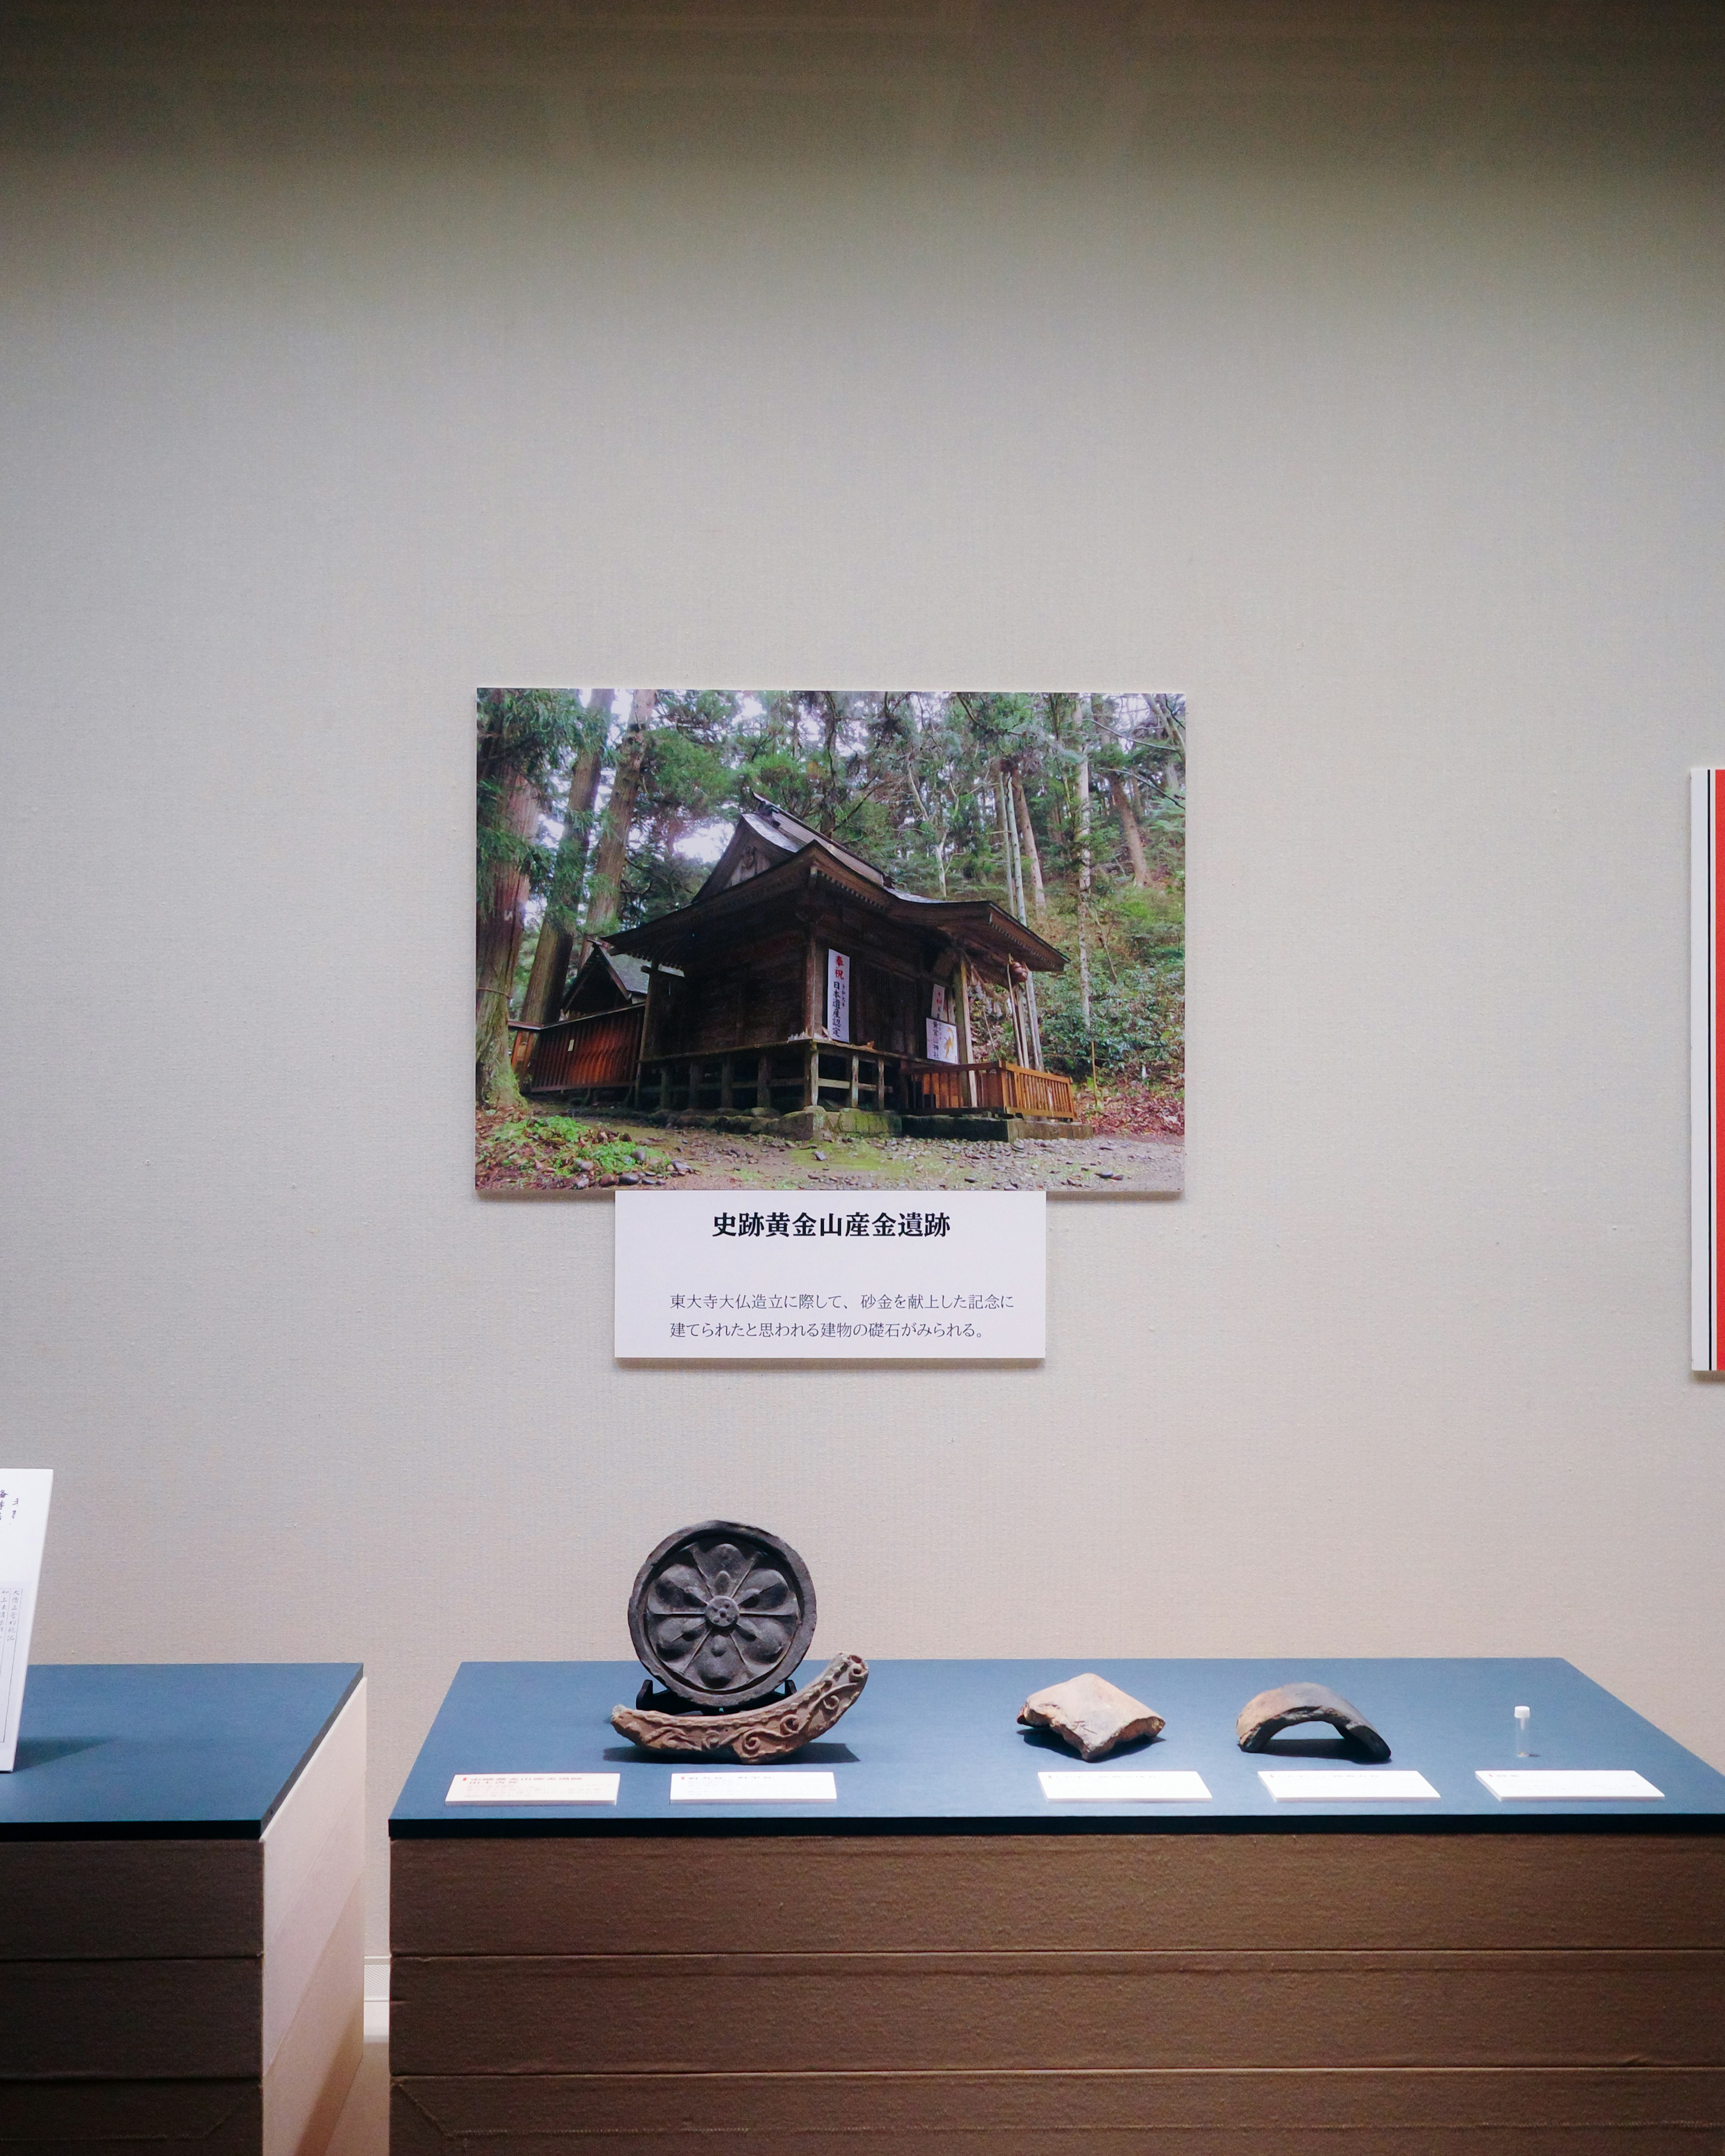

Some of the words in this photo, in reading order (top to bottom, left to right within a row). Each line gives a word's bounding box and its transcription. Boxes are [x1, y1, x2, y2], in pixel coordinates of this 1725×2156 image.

[712, 1211, 951, 1237] 史跡黄金山産金遺跡
[670, 1294, 1014, 1309] 東大寺大仏造立に際して、砂金を献上した記念に
[670, 1322, 982, 1338] 建てられたと思われる建物の礎石がみられる。
